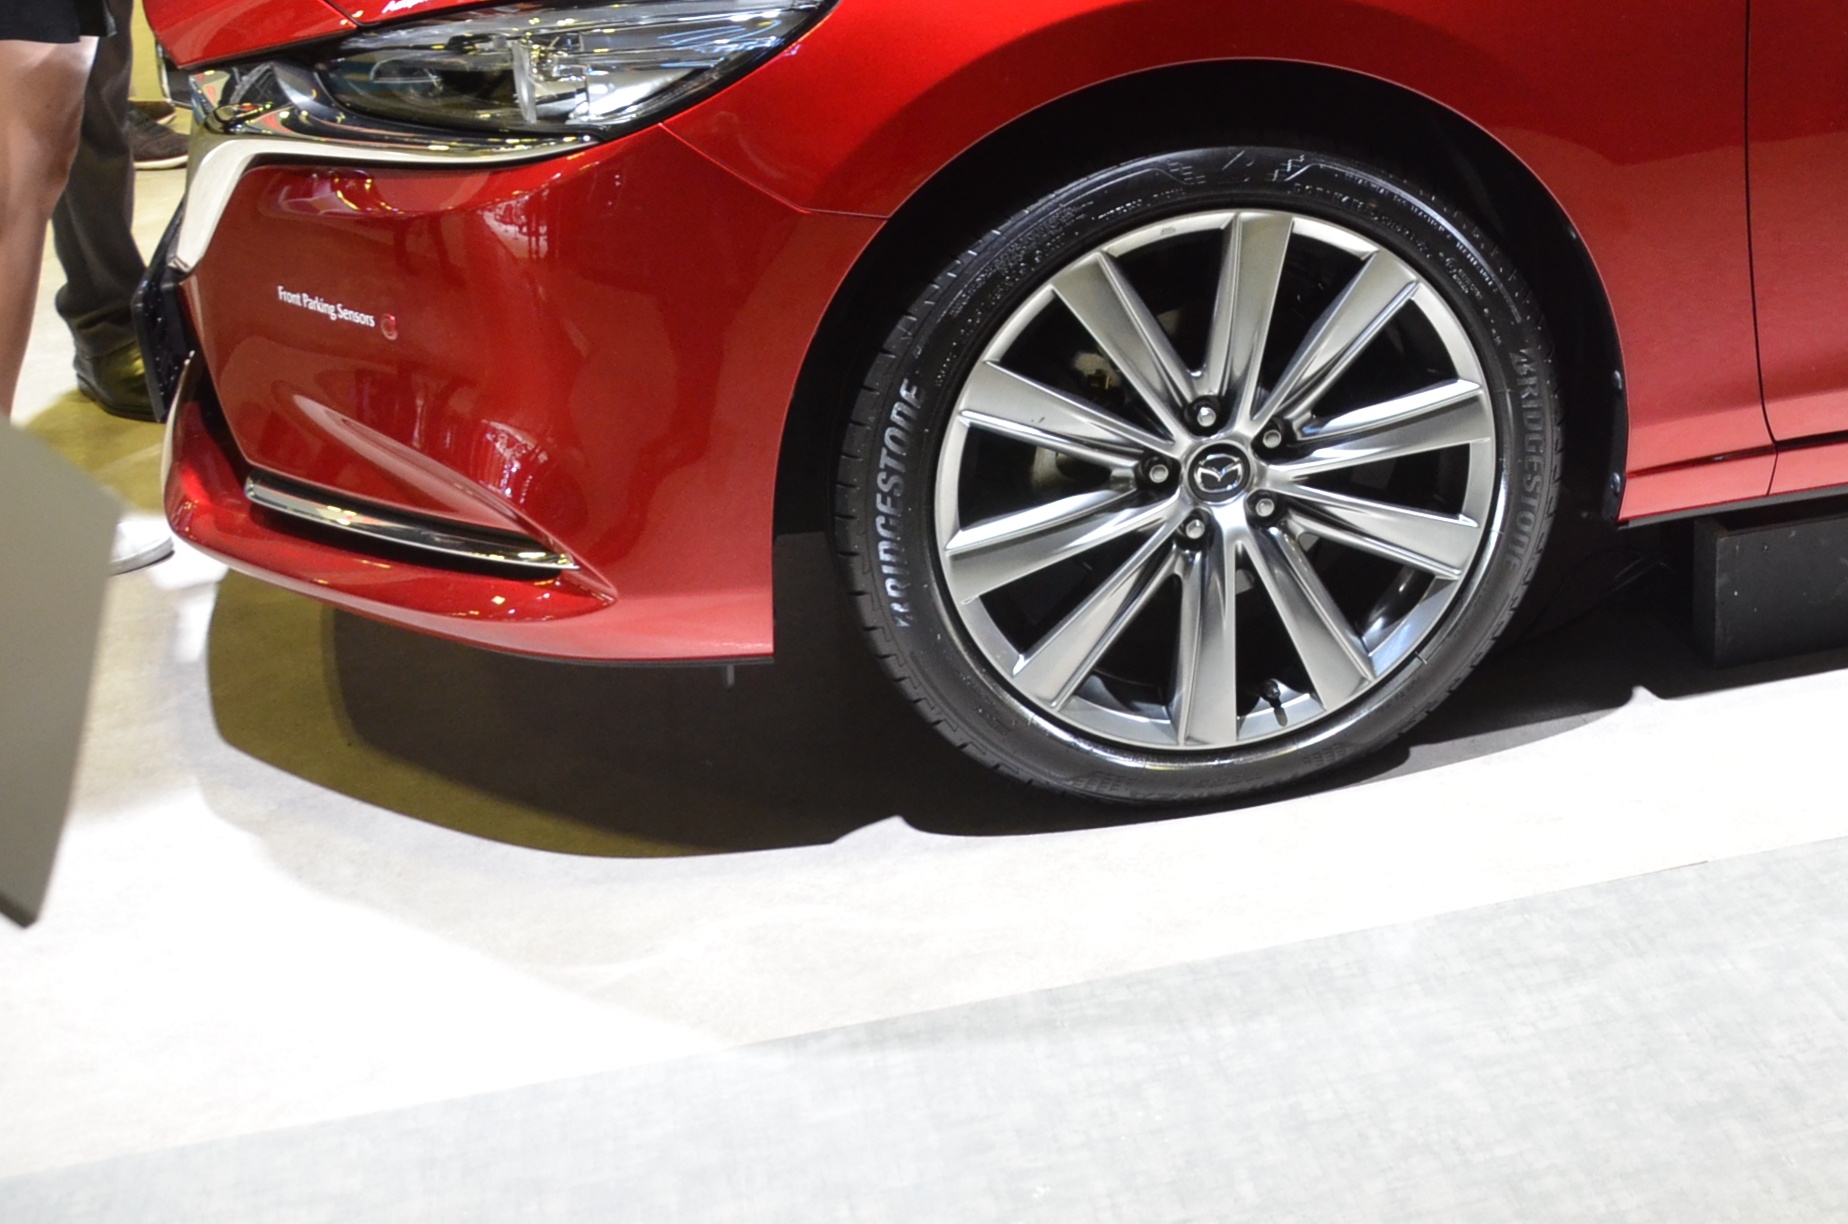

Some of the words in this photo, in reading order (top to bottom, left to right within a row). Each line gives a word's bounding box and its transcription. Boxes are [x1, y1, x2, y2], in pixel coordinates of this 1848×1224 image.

[277, 285, 302, 307] Front
[302, 292, 336, 321] Parking
[336, 303, 375, 328] Sensors
[875, 377, 924, 627] BRIDGESTONE
